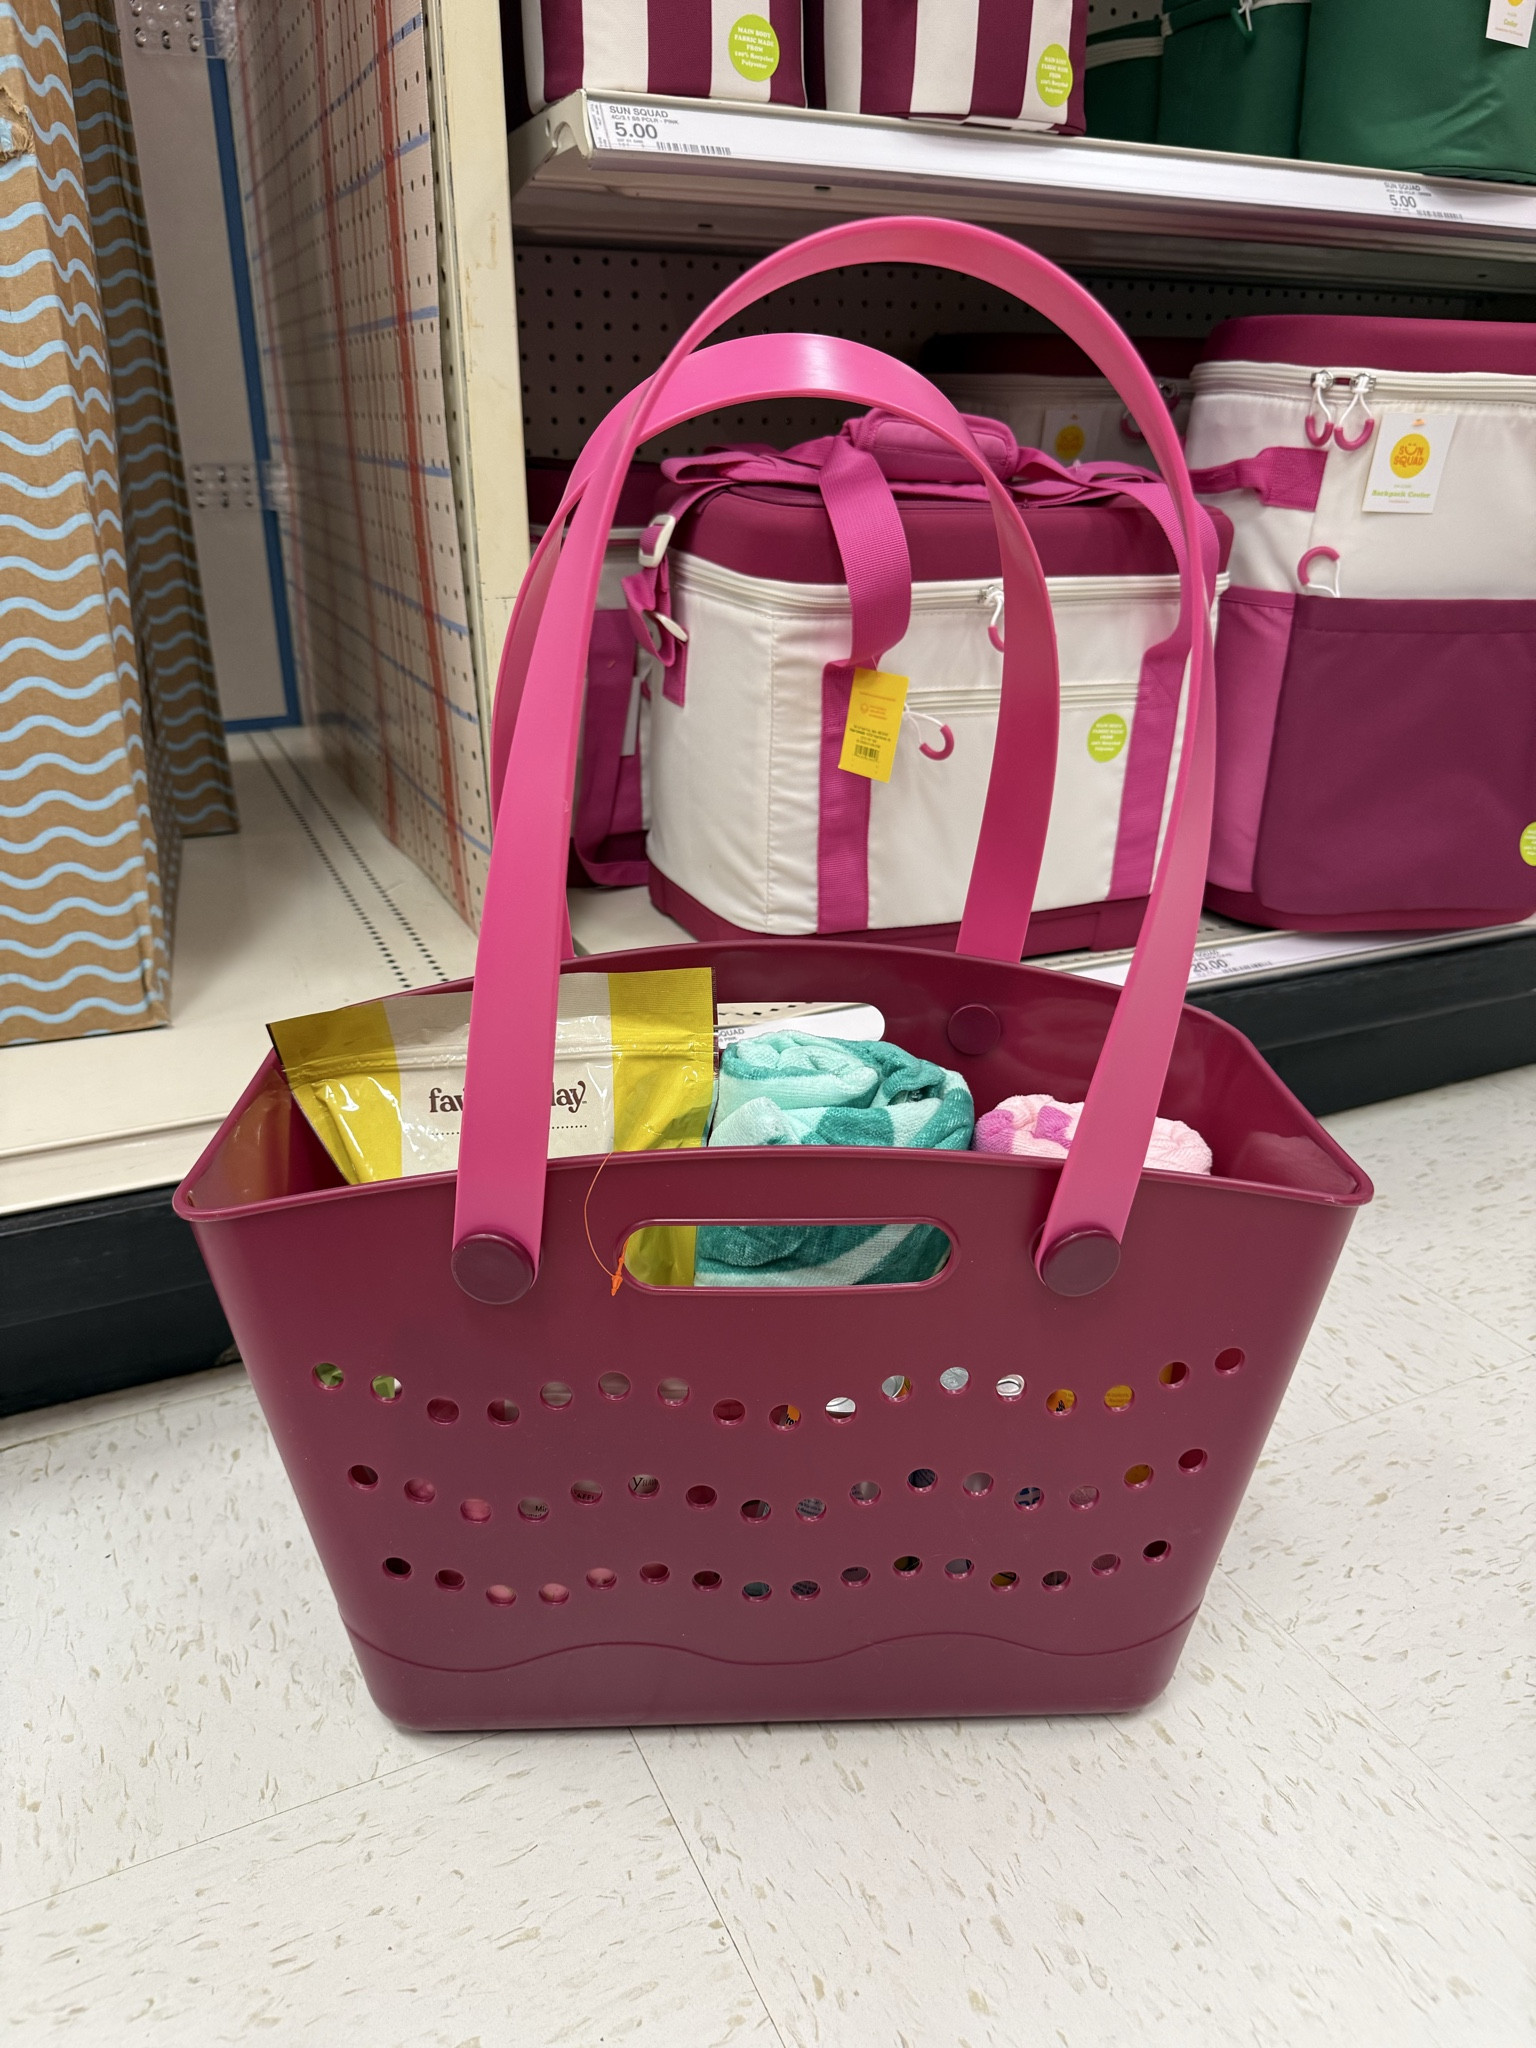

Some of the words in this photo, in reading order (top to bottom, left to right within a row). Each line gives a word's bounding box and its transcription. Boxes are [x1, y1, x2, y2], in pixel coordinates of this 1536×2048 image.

[737, 26, 755, 35] MAIN
[734, 34, 757, 44] FABRIC
[757, 38, 775, 48] MADE
[746, 43, 764, 53] FROM
[609, 105, 631, 115] SUN
[632, 107, 669, 118] SQUAD
[614, 121, 658, 140] 5.00
[1388, 194, 1417, 209] 5.00
[1393, 455, 1425, 468] SQUAD
[719, 1028, 745, 1038] QUAD
